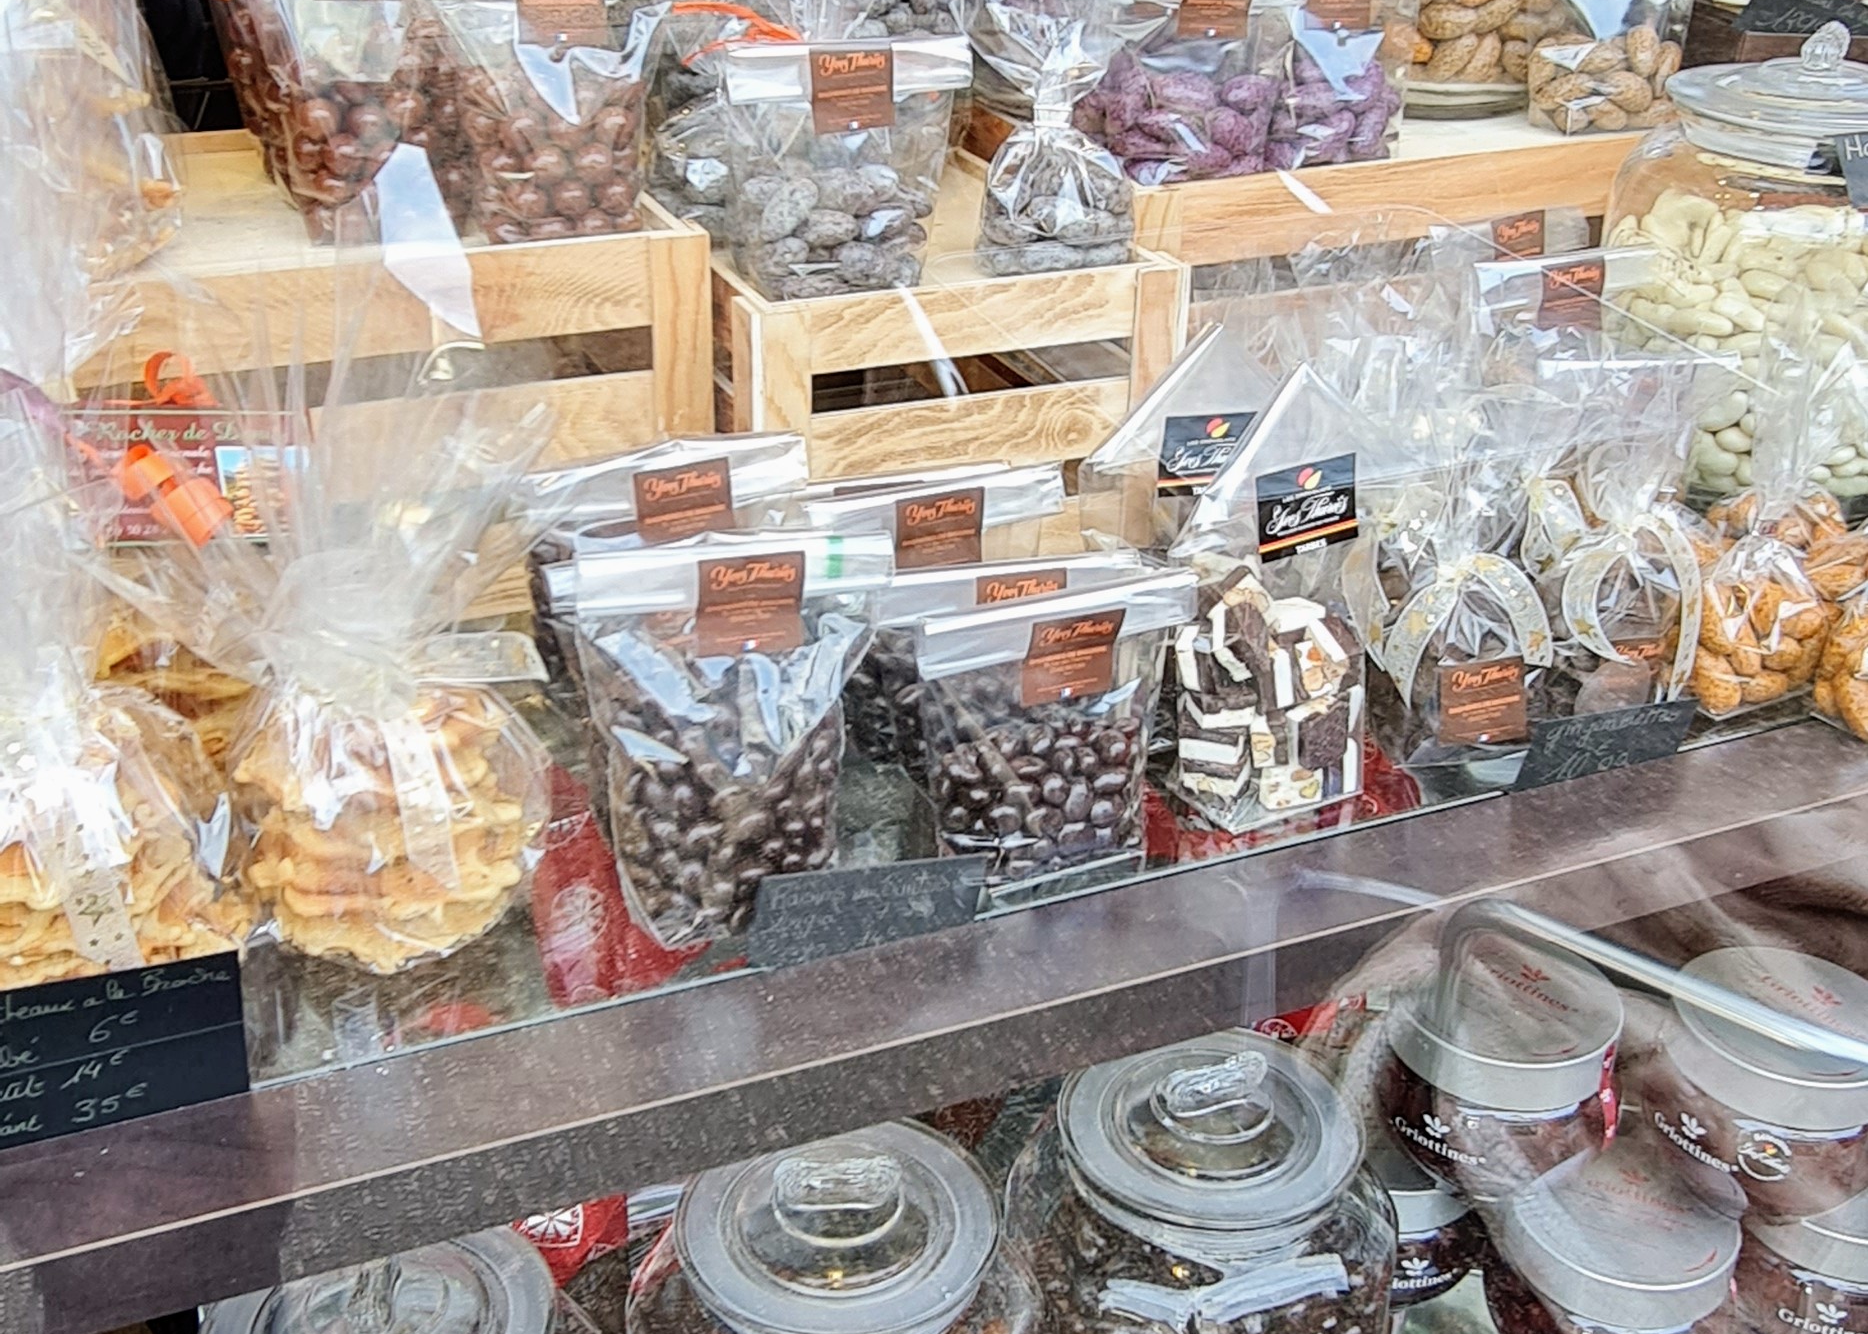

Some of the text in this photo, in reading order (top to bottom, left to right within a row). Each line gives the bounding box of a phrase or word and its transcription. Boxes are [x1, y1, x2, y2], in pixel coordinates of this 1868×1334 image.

[0, 993, 76, 1022] teaux
[71, 1082, 148, 1123] 35€
[1394, 1115, 1479, 1167] Griottines
[1654, 1111, 1732, 1173] Griottines
[1390, 1272, 1453, 1291] iottines
